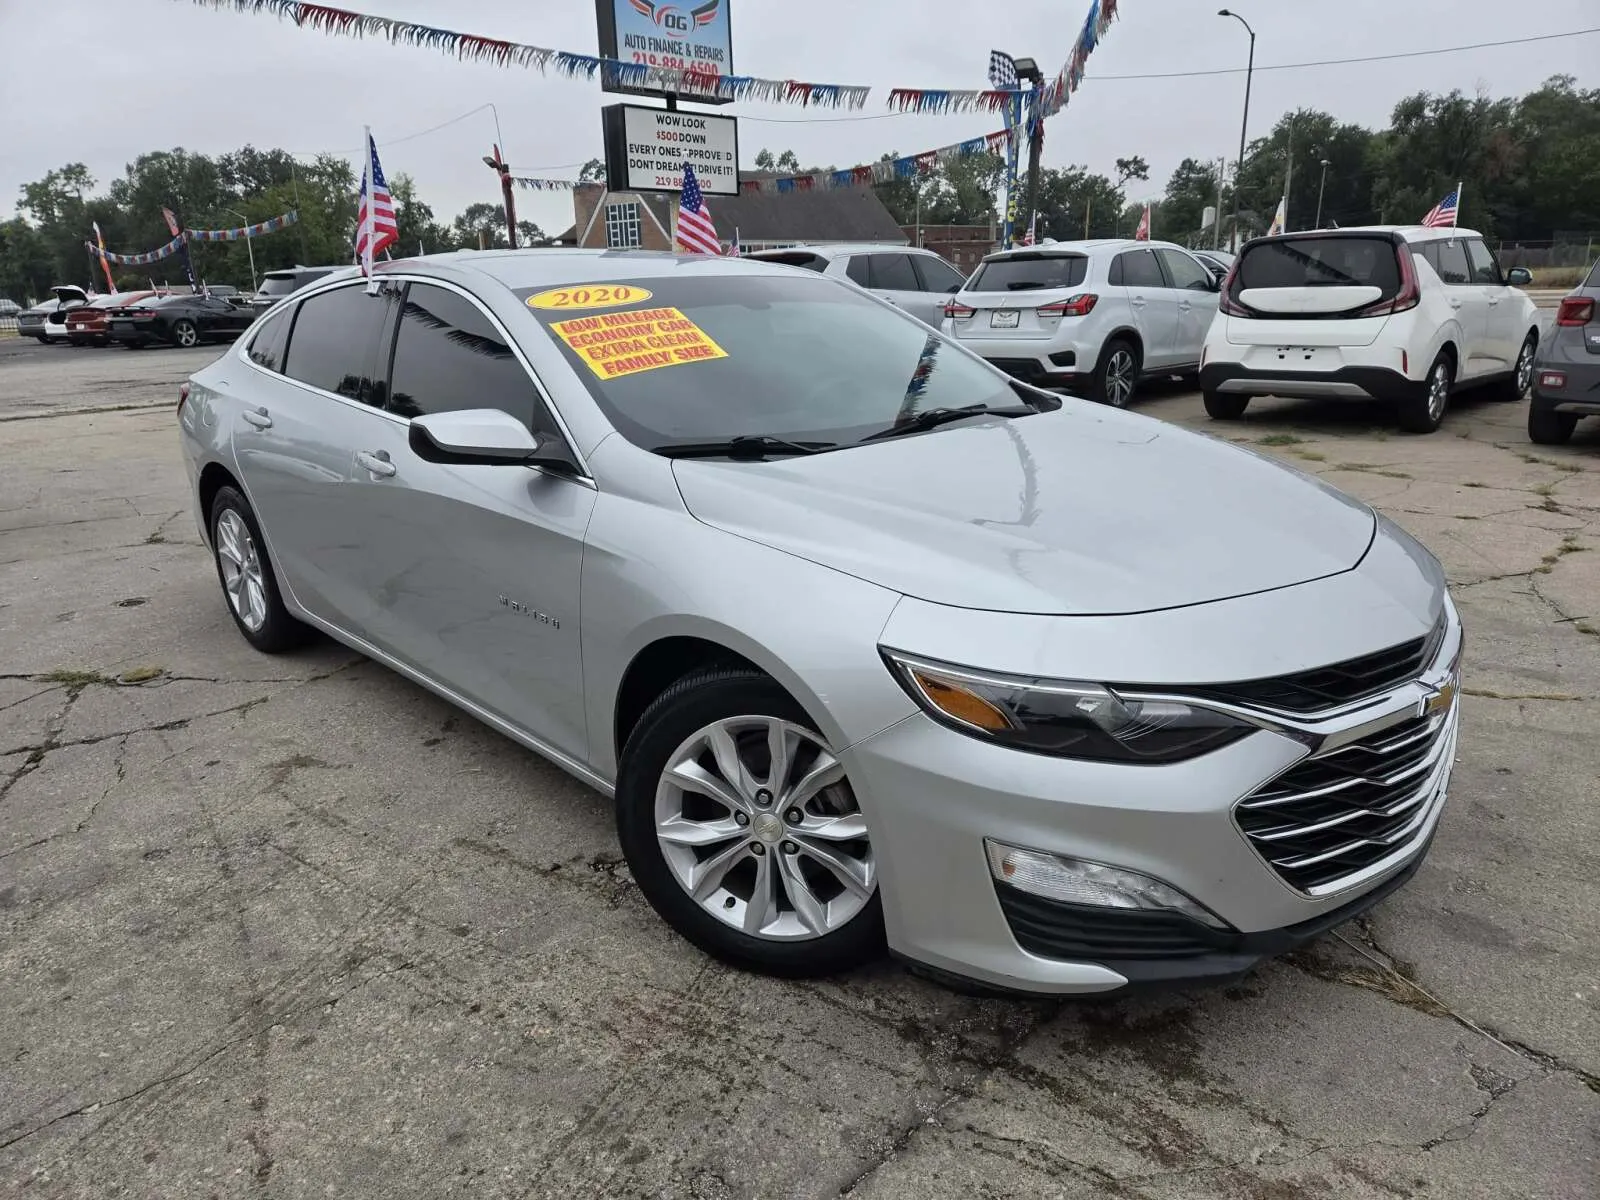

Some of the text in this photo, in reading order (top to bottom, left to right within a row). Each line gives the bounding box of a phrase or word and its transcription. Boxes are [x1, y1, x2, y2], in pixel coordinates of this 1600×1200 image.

[664, 14, 688, 31] OG
[624, 33, 725, 62] AUTO FINANCE & REPAIRS
[656, 114, 706, 129] WOW LOOK
[656, 131, 706, 145] $500 DOWN
[629, 143, 657, 156] EVERY
[658, 146, 681, 158] ONES
[630, 159, 655, 170] DONT
[698, 165, 722, 175] DRIVE
[723, 166, 733, 176] IT!
[655, 176, 672, 186] 219
[552, 287, 631, 307] 2020
[560, 308, 676, 335] LOW MILEAGE
[568, 319, 694, 348] ECONOMY CAR
[586, 332, 703, 360] EXTRA CLEAN
[601, 344, 717, 375] FAMILY SIZE
